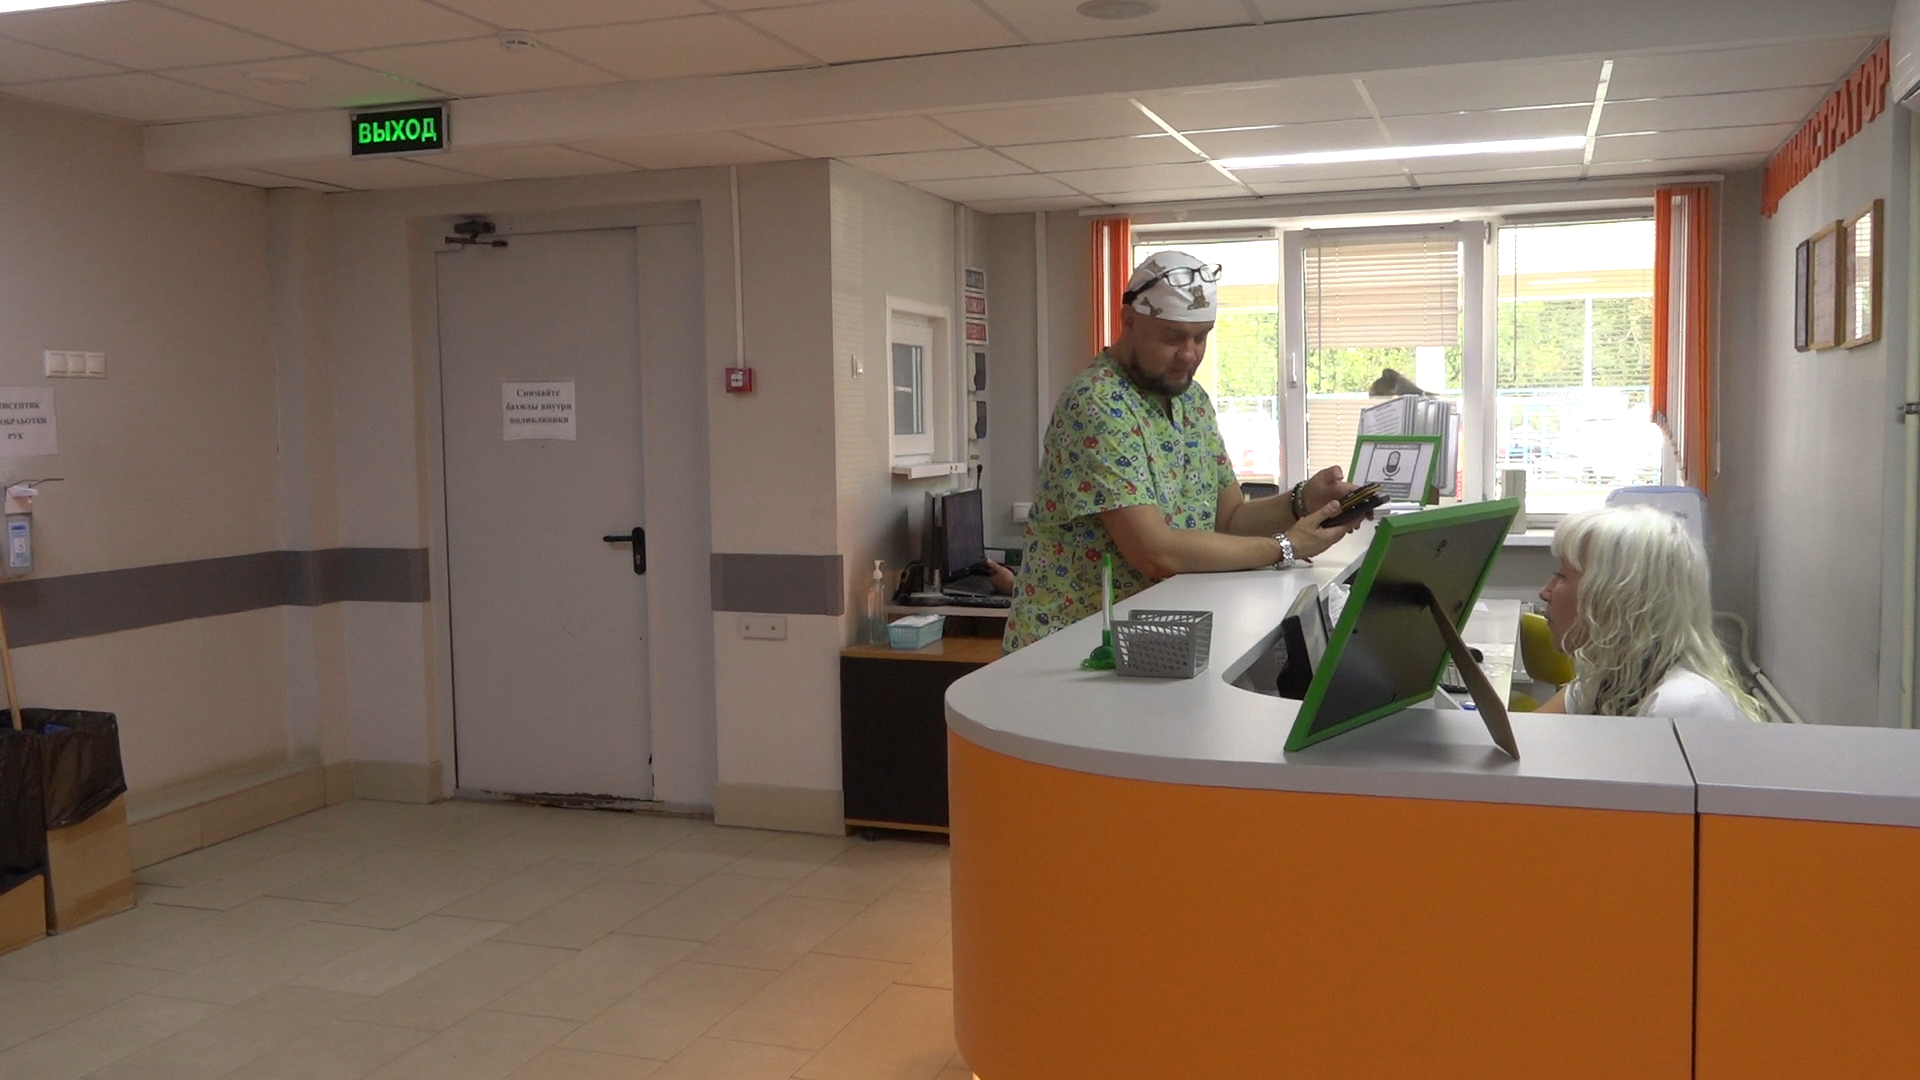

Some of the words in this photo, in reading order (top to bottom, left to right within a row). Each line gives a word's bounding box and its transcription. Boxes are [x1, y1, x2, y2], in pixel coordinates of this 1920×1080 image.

[358, 117, 437, 144] ВЫХОД
[516, 388, 561, 398] Снимайте
[505, 402, 538, 411] бахилы
[540, 403, 572, 413] внутри
[509, 417, 569, 425] поликлиники
[8, 432, 23, 441] РУК
